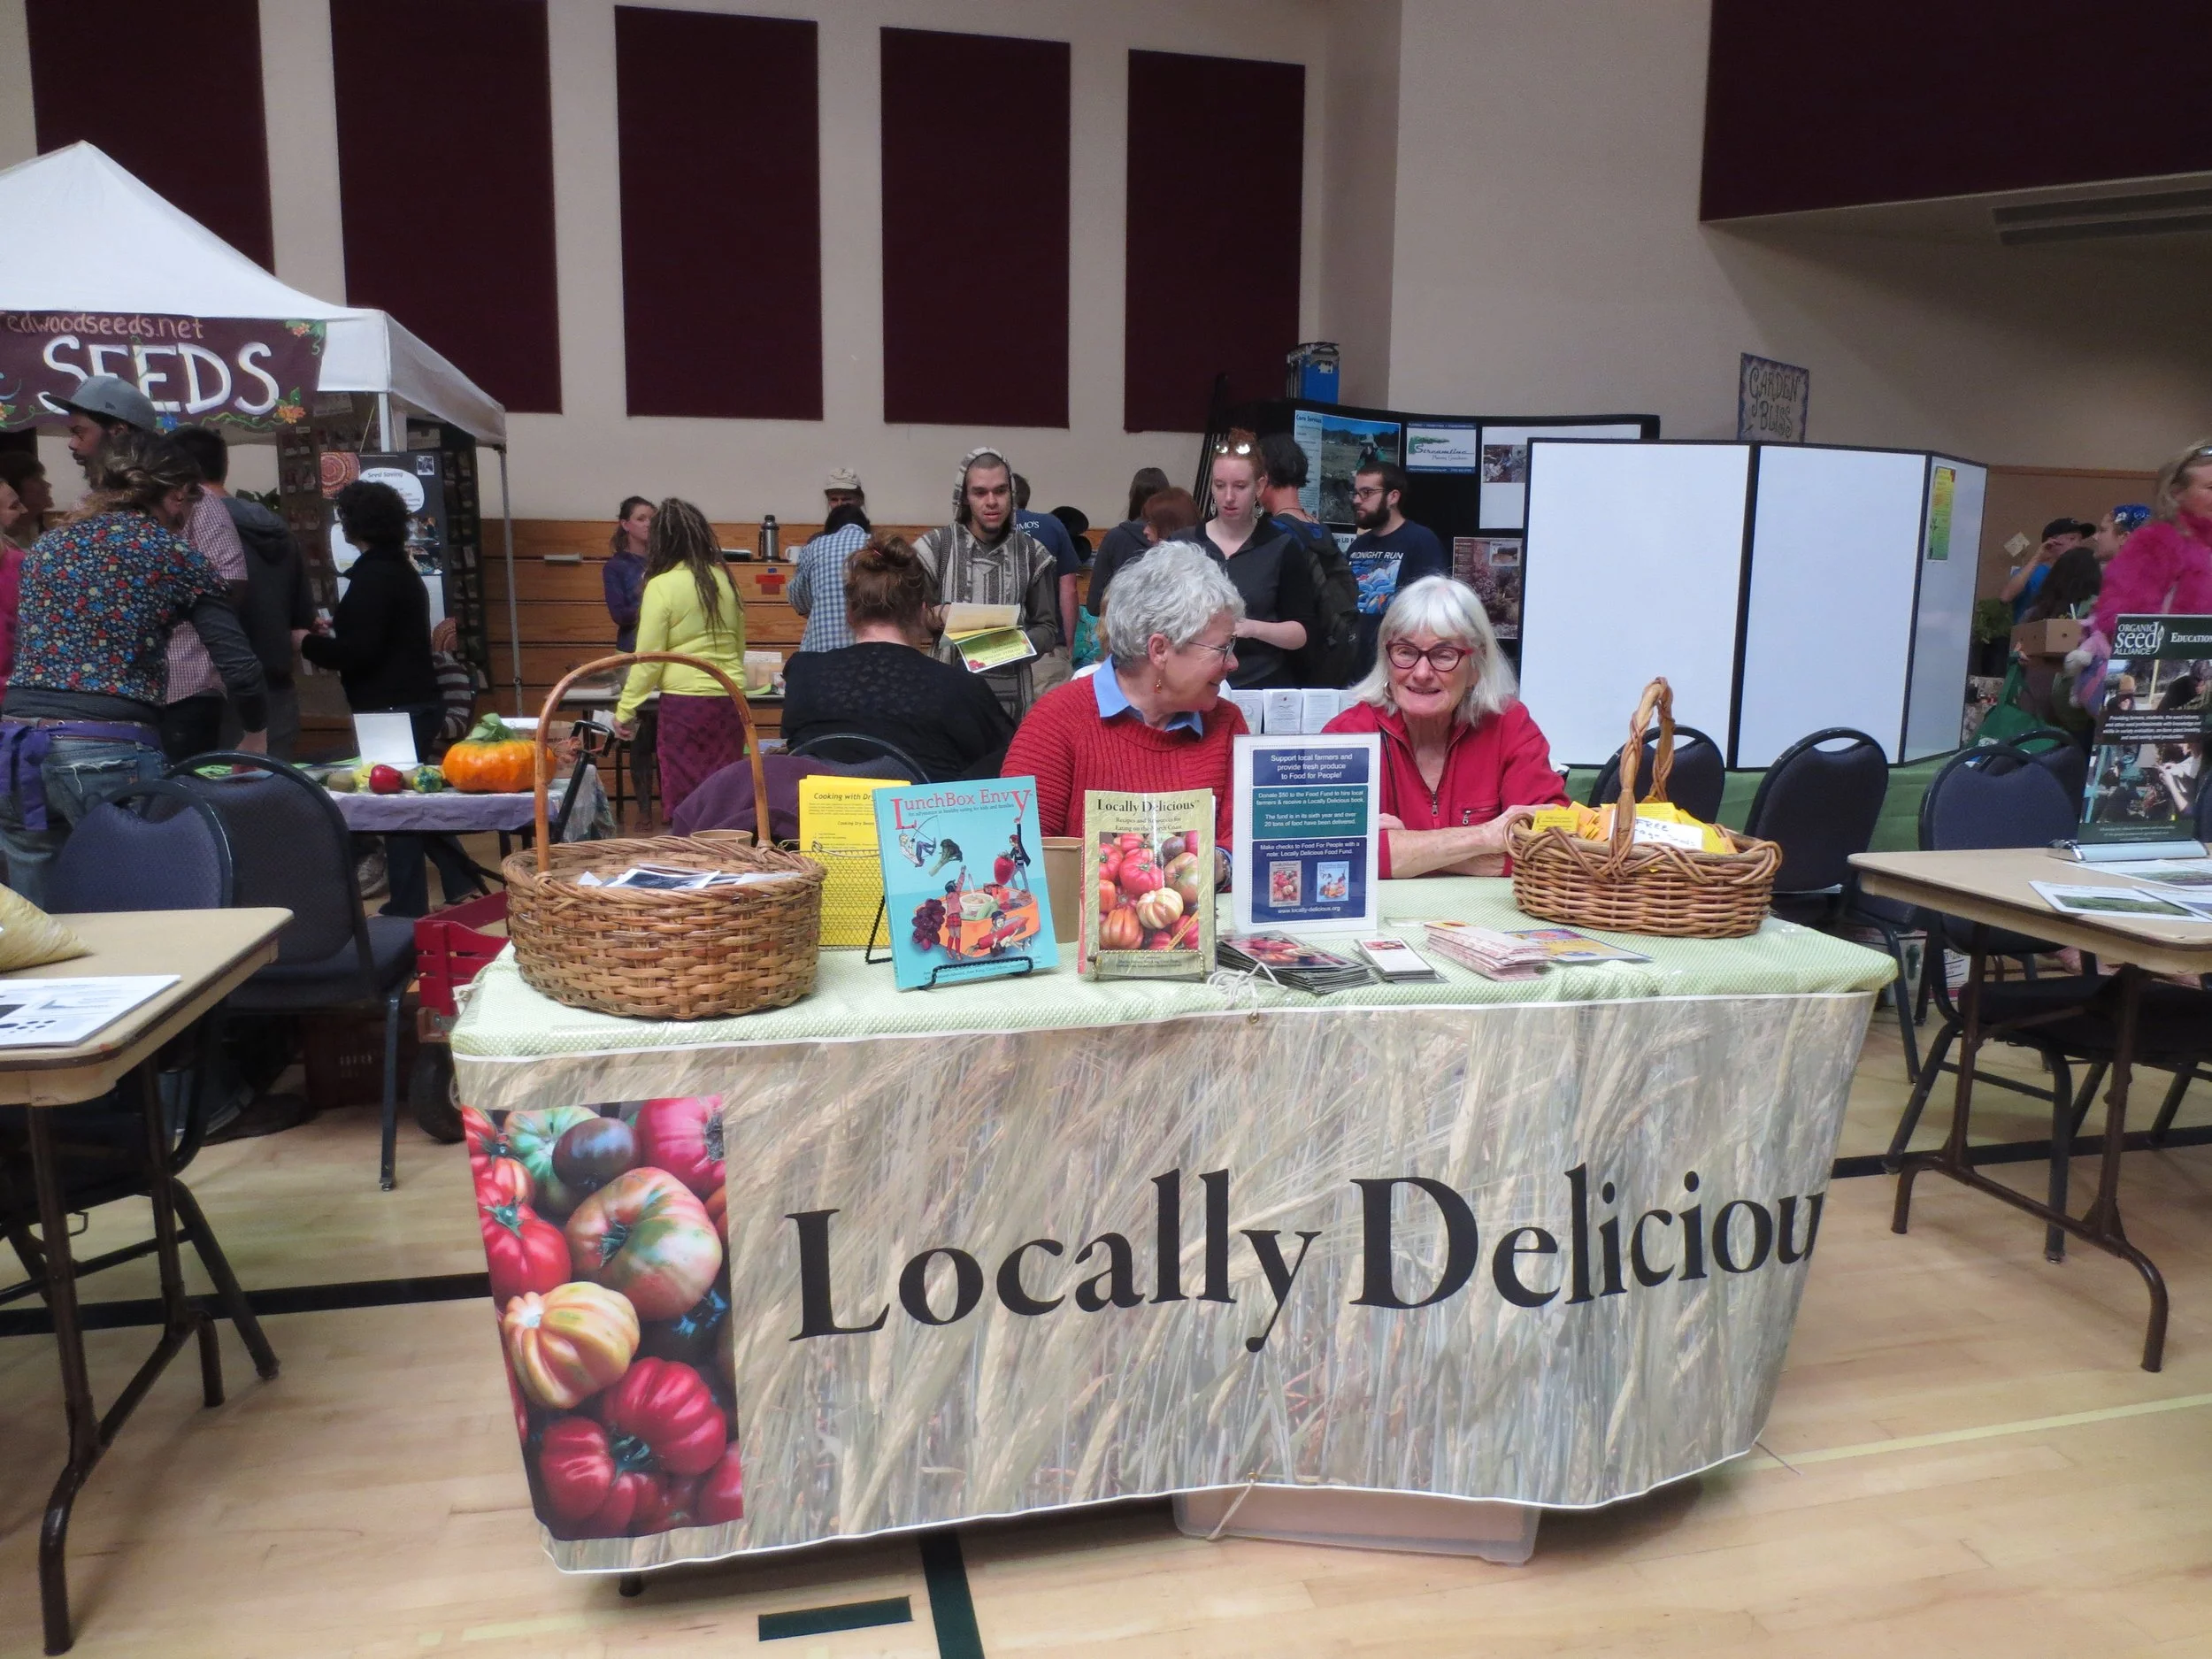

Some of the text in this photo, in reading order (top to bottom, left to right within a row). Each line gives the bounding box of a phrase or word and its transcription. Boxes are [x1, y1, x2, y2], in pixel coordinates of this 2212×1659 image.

[7, 312, 204, 339] edwoodseeds.net
[1749, 366, 1801, 418] GARDEN
[1759, 400, 1793, 439] BLISS
[1414, 443, 1467, 454] Streamline
[2115, 621, 2161, 654] seed
[1317, 772, 1342, 780] People!
[890, 789, 1031, 830] LunchBox Envy
[1097, 799, 1140, 816] Locally
[782, 1161, 1825, 1354] Locally Deliciou
